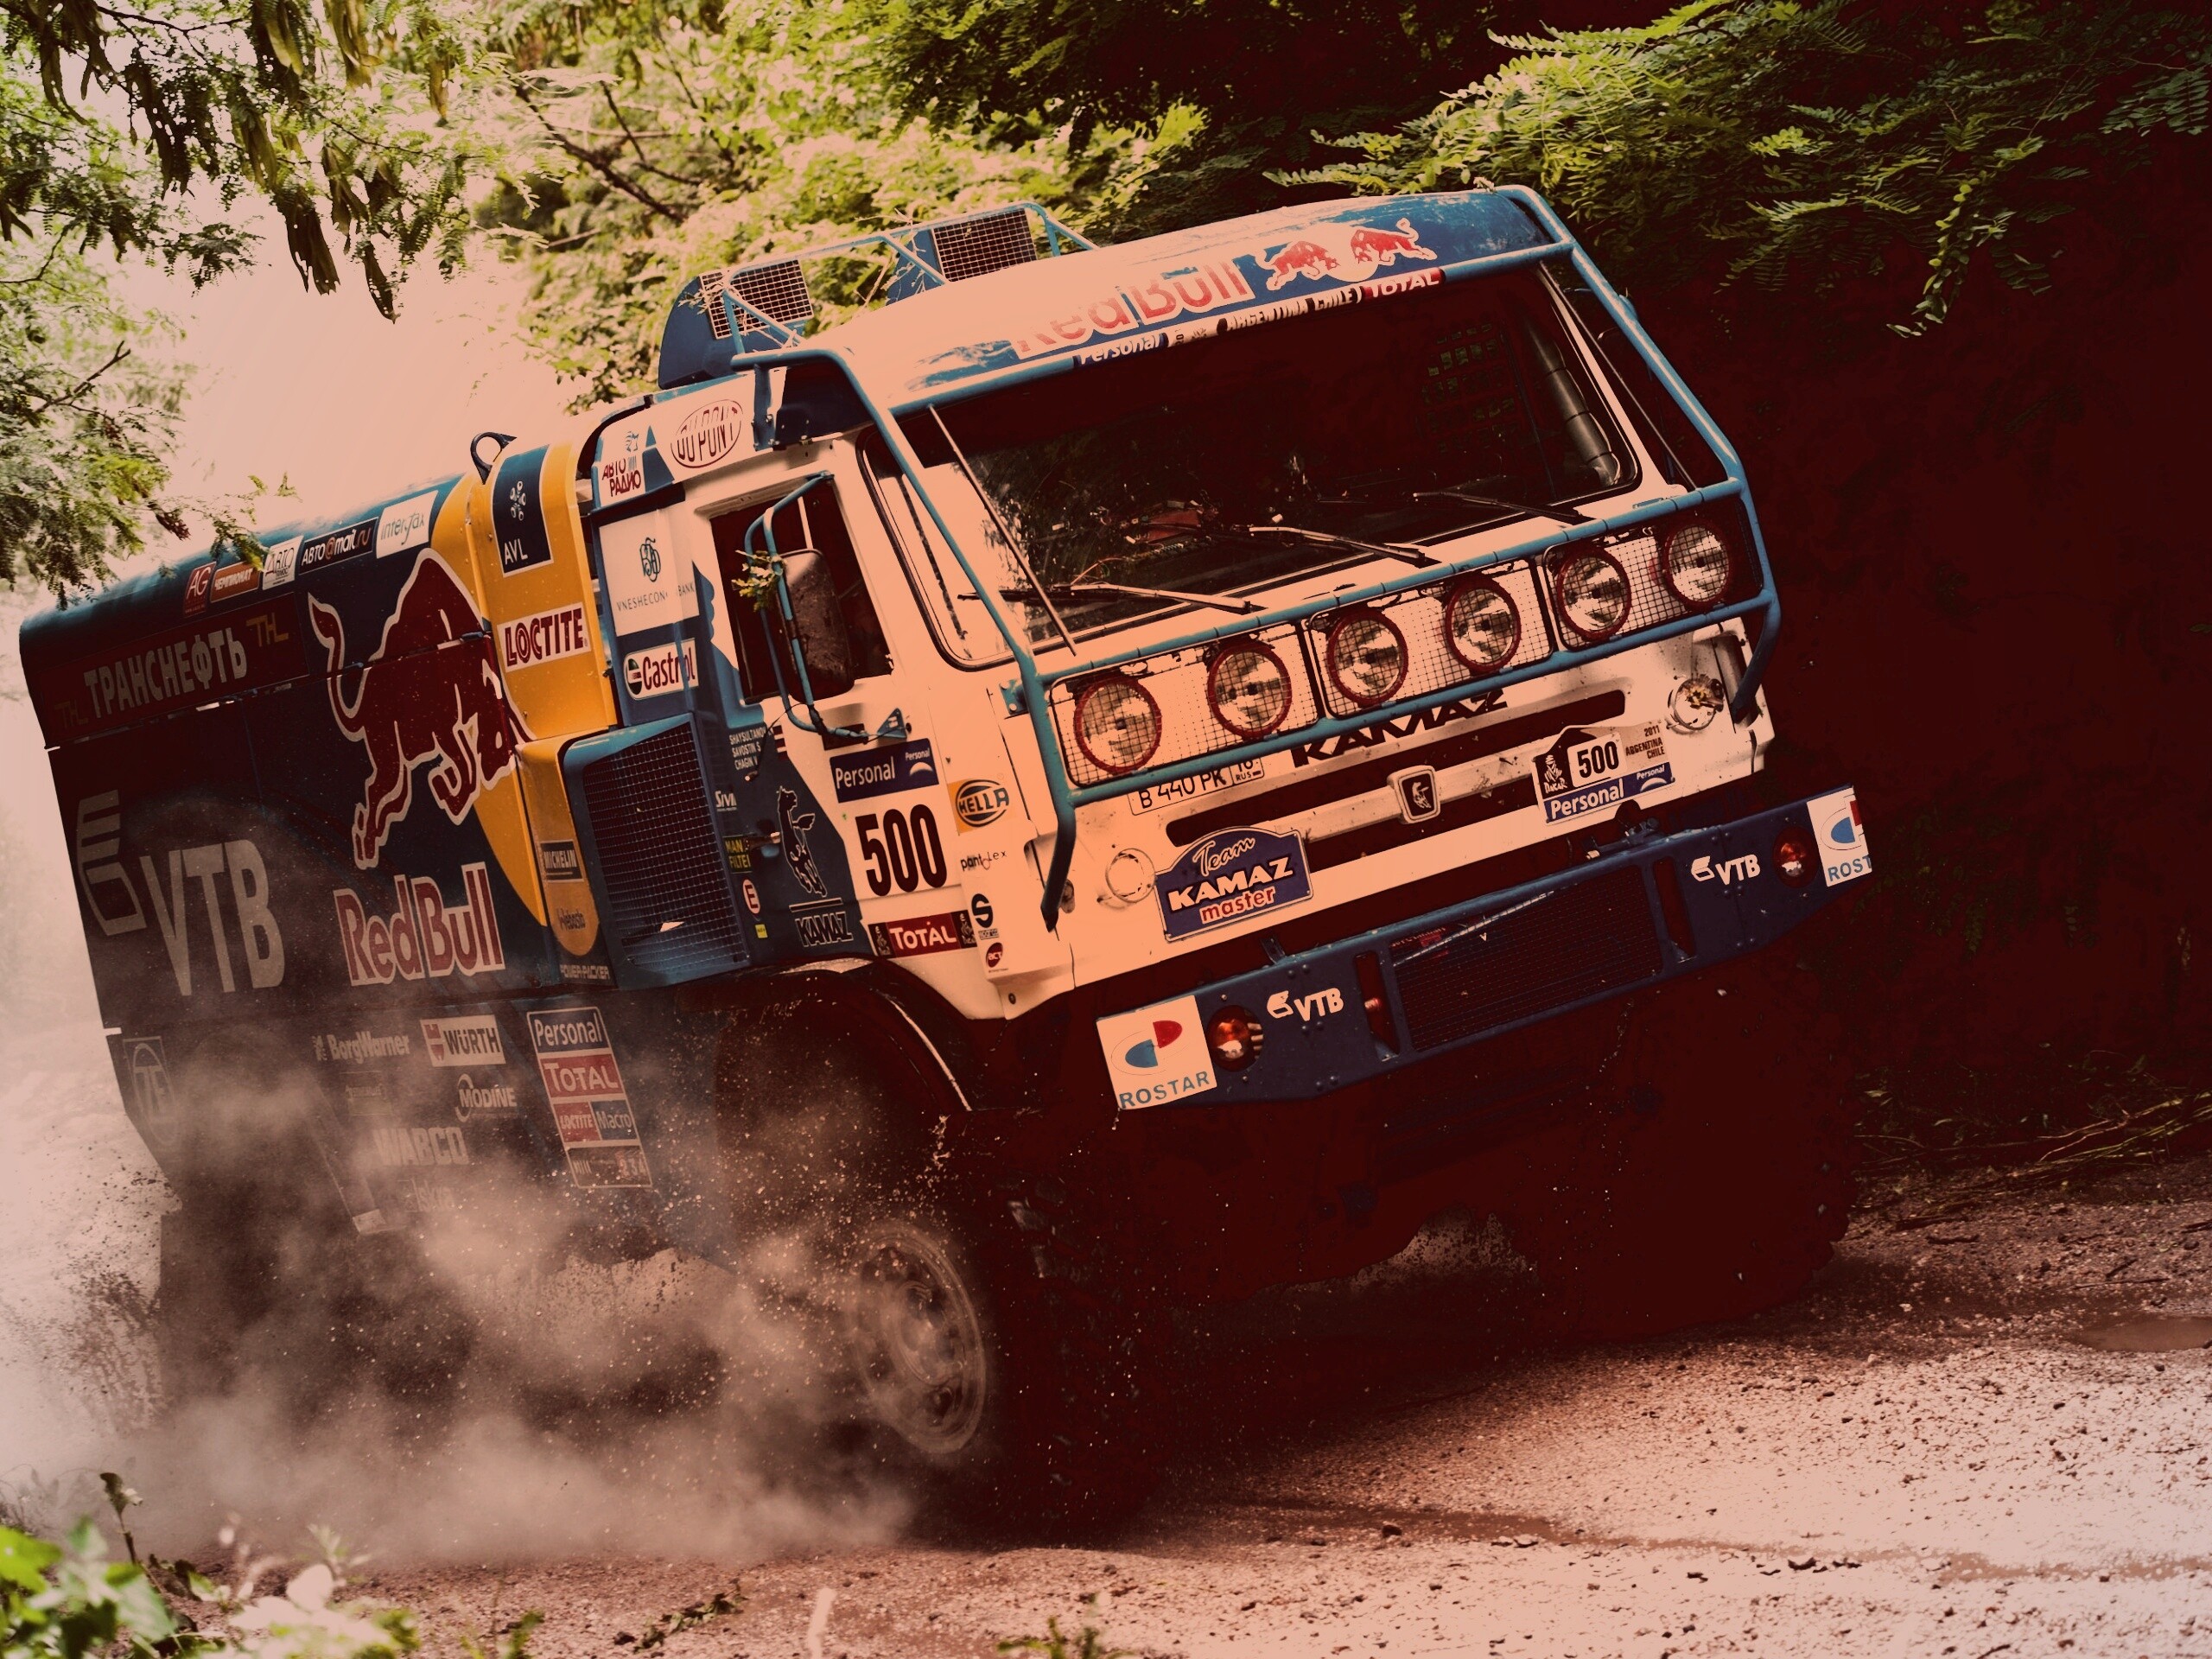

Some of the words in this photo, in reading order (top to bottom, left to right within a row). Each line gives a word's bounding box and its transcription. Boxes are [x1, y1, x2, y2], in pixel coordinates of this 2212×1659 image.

[1370, 270, 1440, 297] TOTAL
[609, 470, 641, 497] РАДИО
[504, 539, 528, 565] AVL
[186, 567, 211, 600] AG
[505, 611, 584, 669] LOCTITE
[84, 627, 247, 719] ТРАНСНЕФТЬ
[1625, 737, 1663, 756] ARGENTINA
[1644, 725, 1660, 737] 2011
[906, 748, 930, 760] Personal
[1577, 741, 1619, 778] 500
[1647, 747, 1665, 759] CHILE
[836, 758, 895, 789] Personal
[1236, 772, 1251, 781] RUS
[1637, 764, 1665, 780] Personal
[959, 787, 1009, 813] HELLA
[1139, 790, 1153, 809] B
[1158, 778, 1196, 800] 440
[1550, 778, 1624, 820] Personal
[855, 804, 947, 896] 500
[1193, 836, 1255, 877] Team
[1168, 856, 1294, 912] KAMAZ
[1715, 854, 1760, 885] VTB
[139, 840, 285, 995] VTB
[1201, 887, 1276, 924] master
[795, 912, 854, 947] KAMAZ
[889, 925, 957, 950] TOTAL
[1294, 988, 1344, 1021] VTB
[443, 1027, 500, 1055] WÜRTH
[535, 1013, 602, 1046] Personal
[327, 1031, 410, 1064] BorgWarner
[544, 1063, 618, 1091] TOTAL
[1119, 1071, 1211, 1108] ROSTAR
[460, 1088, 517, 1107] MODINE
[560, 1114, 593, 1128] LOCTITE
[596, 1111, 632, 1128] Macro
[373, 1127, 469, 1165] WABCO
